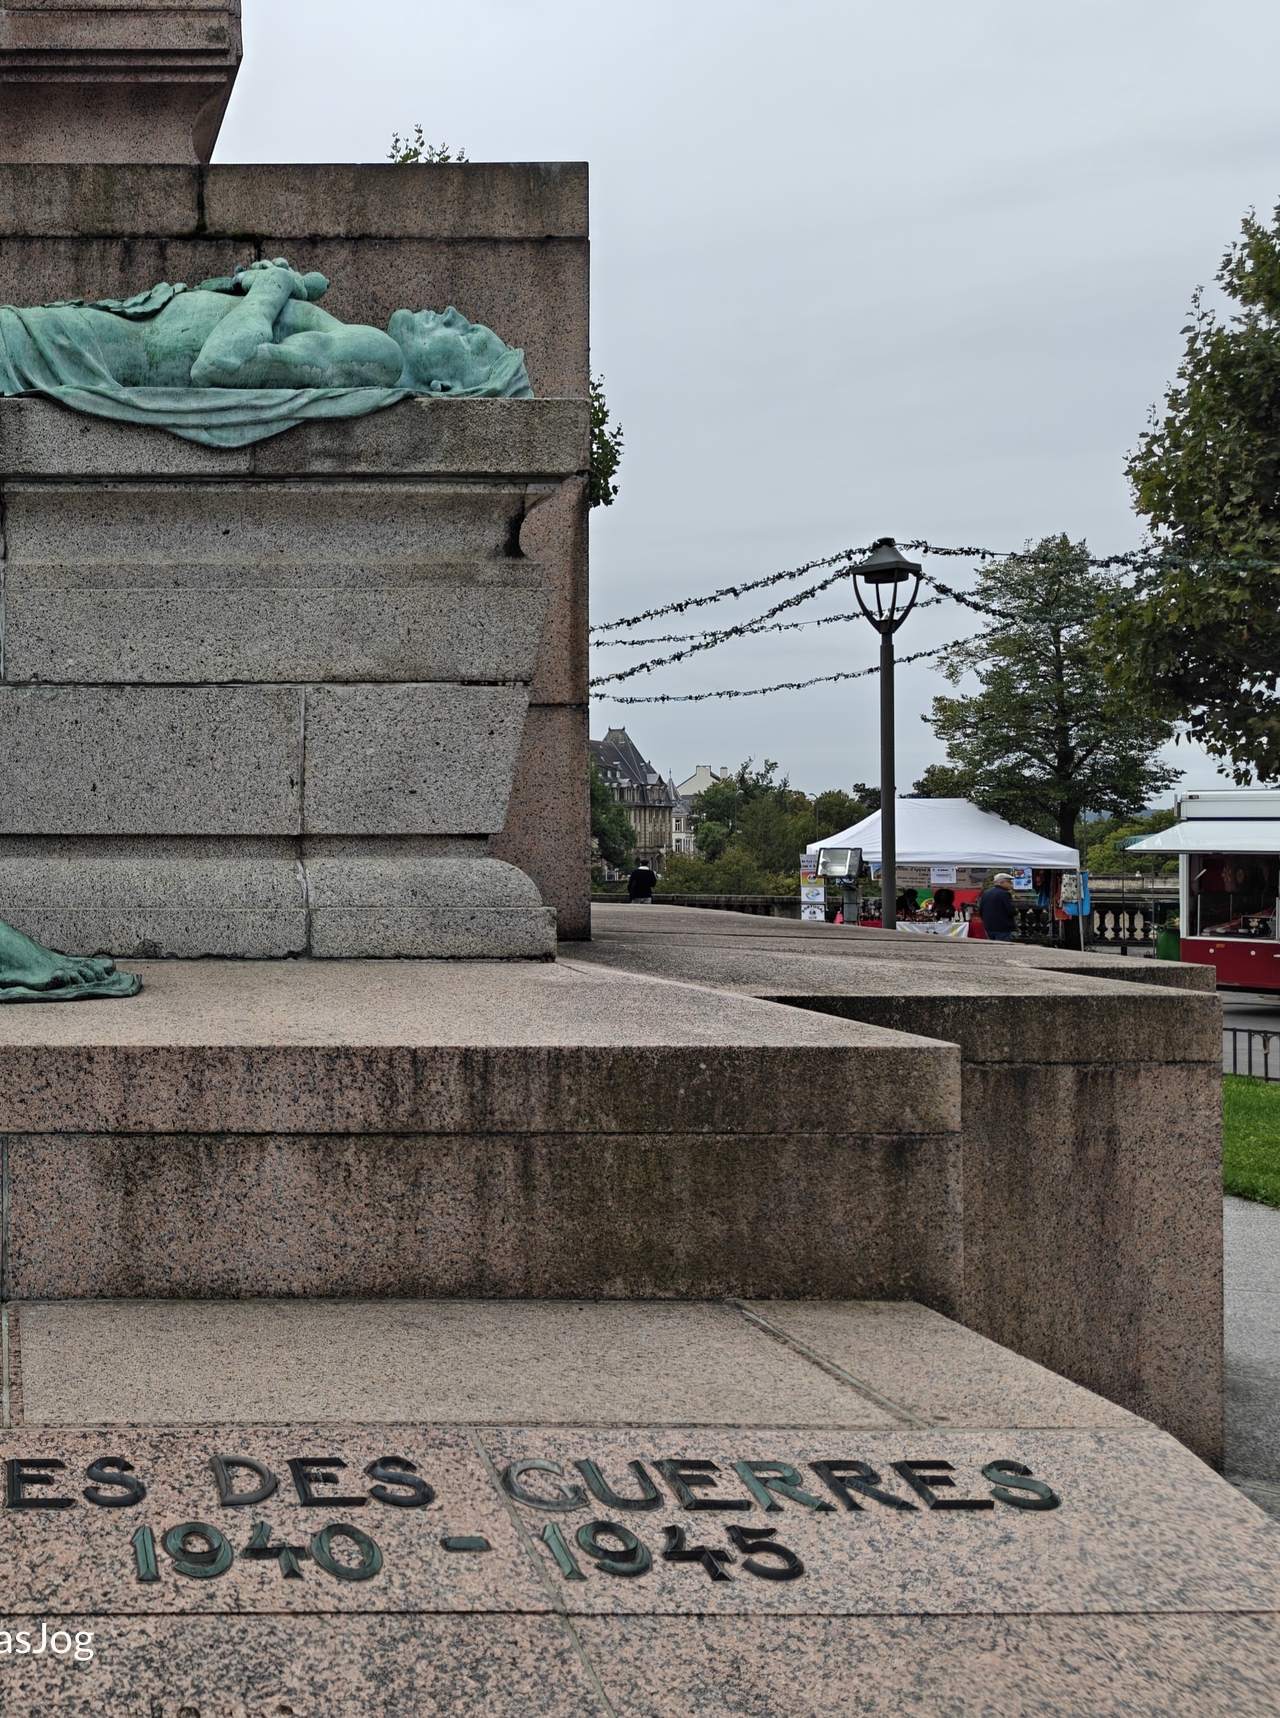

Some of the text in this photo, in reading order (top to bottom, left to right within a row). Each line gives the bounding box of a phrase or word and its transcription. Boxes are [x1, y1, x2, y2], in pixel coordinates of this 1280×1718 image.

[802, 905, 824, 914] PORTUGAL
[210, 1455, 436, 1508] DES
[500, 1458, 1062, 1512] GUERRES
[129, 1519, 384, 1583] 1940
[440, 1535, 492, 1553] -
[539, 1519, 806, 1583] 1945
